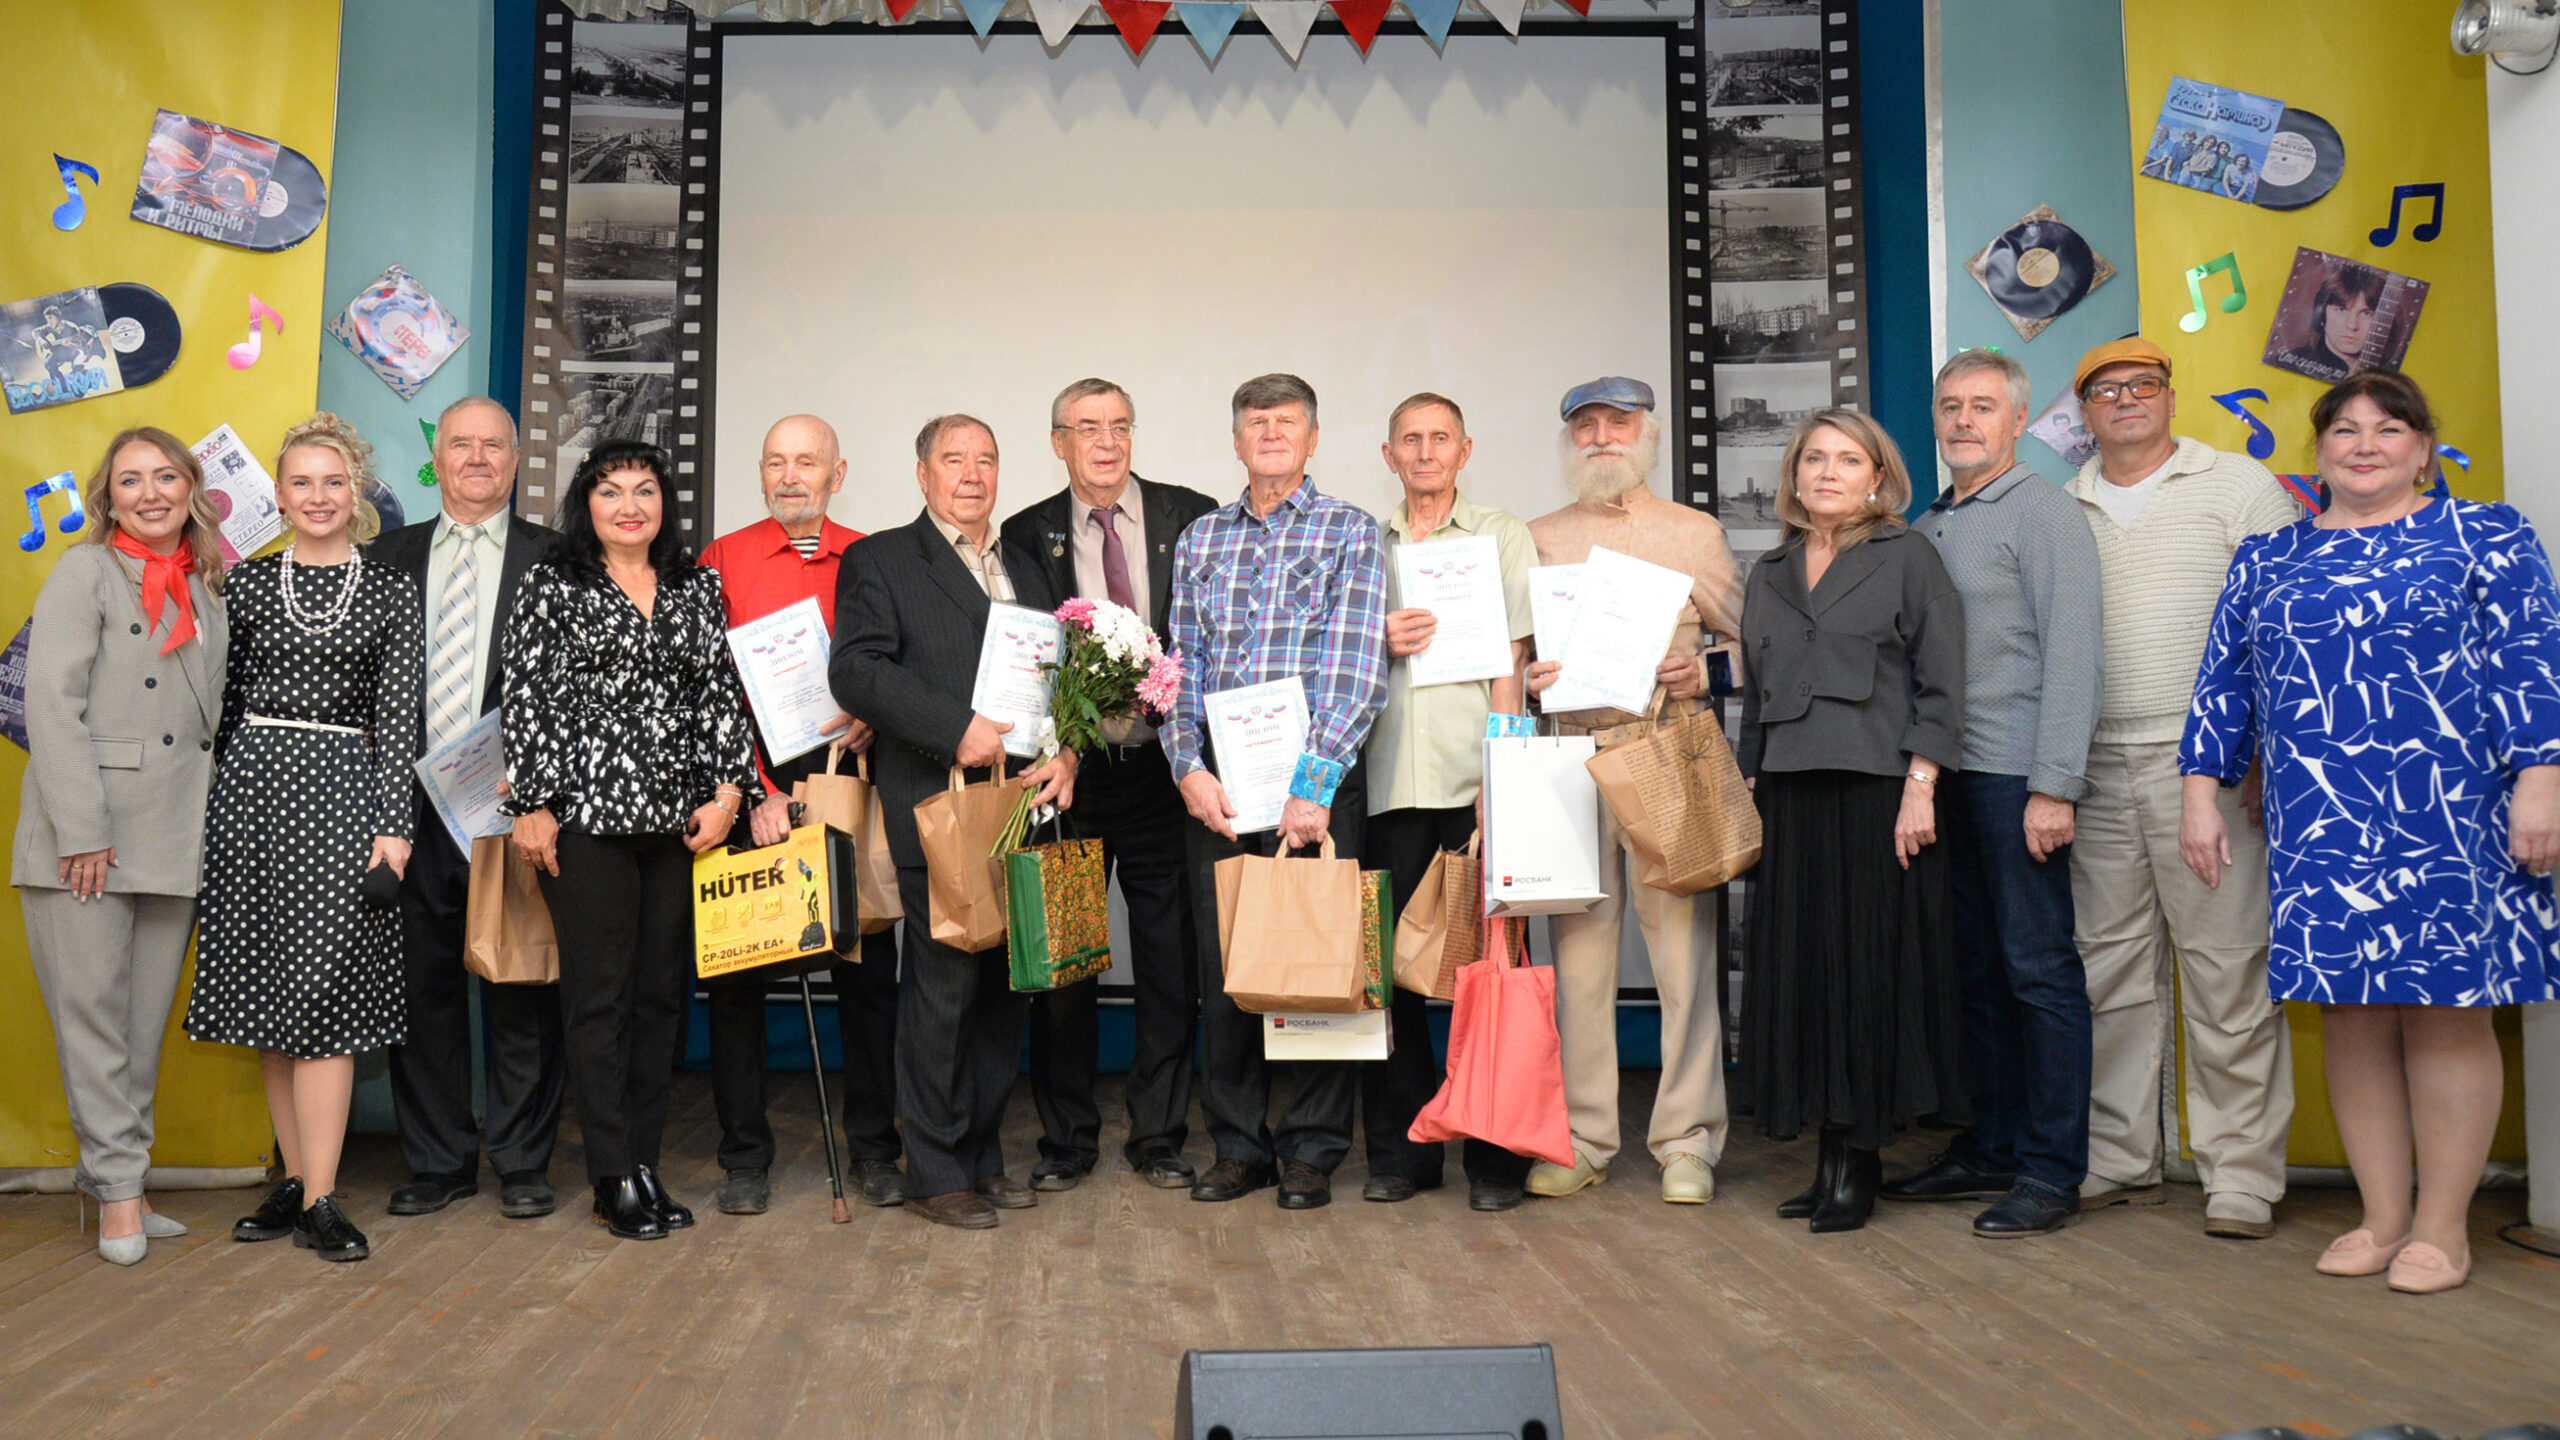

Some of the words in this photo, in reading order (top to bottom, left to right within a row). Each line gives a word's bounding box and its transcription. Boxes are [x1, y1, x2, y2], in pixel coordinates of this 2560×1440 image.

[147, 209, 157, 224] И
[164, 215, 223, 241] РИТМЫ
[168, 199, 244, 232] МЕЛОДИИ
[232, 520, 264, 546] СТЕРЕО
[700, 866, 785, 903] HÜTER
[1514, 876, 1552, 884] РОСБАНК
[763, 938, 785, 950] EA+
[702, 960, 732, 973] Секатор
[1286, 1019, 1330, 1027] РОСБАНК
